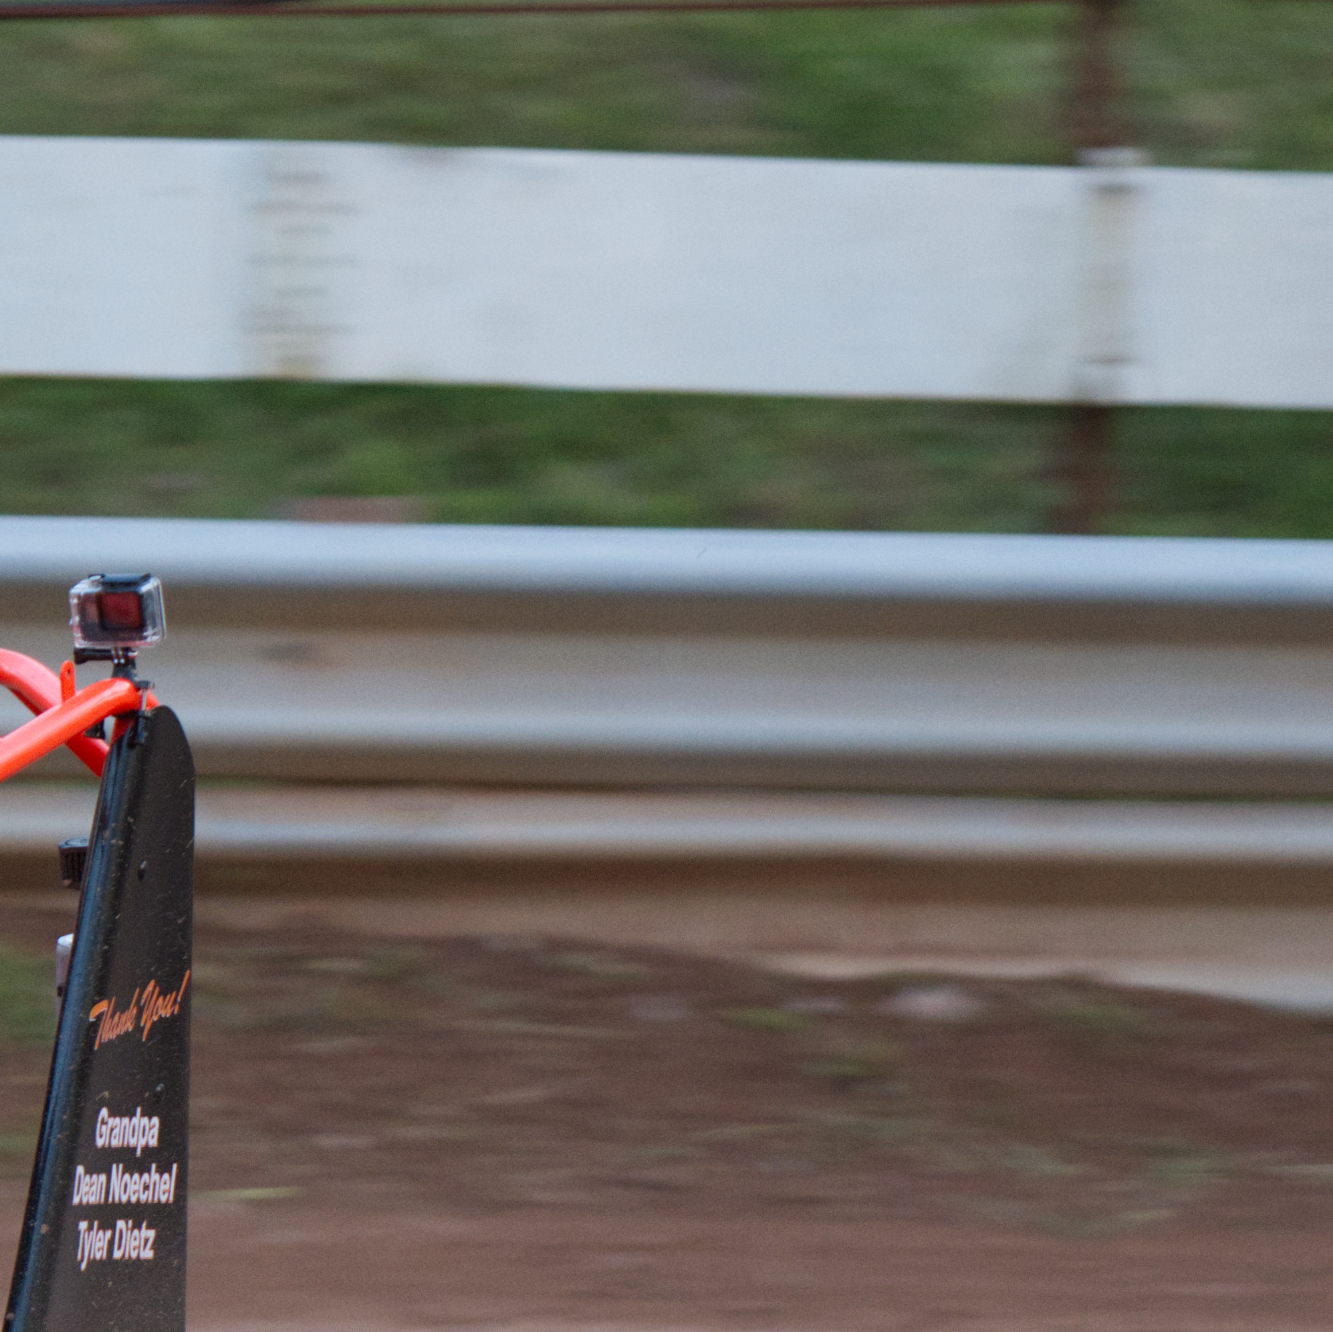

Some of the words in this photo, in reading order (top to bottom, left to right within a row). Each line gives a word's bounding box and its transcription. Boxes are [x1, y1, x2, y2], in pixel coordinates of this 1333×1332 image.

[89, 987, 140, 1050] Thank
[140, 969, 190, 1041] You!
[95, 1106, 160, 1157] Grandpa
[72, 1164, 107, 1206] Dean
[108, 1163, 178, 1204] Noechel
[77, 1219, 113, 1272] Tyler
[112, 1218, 156, 1260] Dietz
